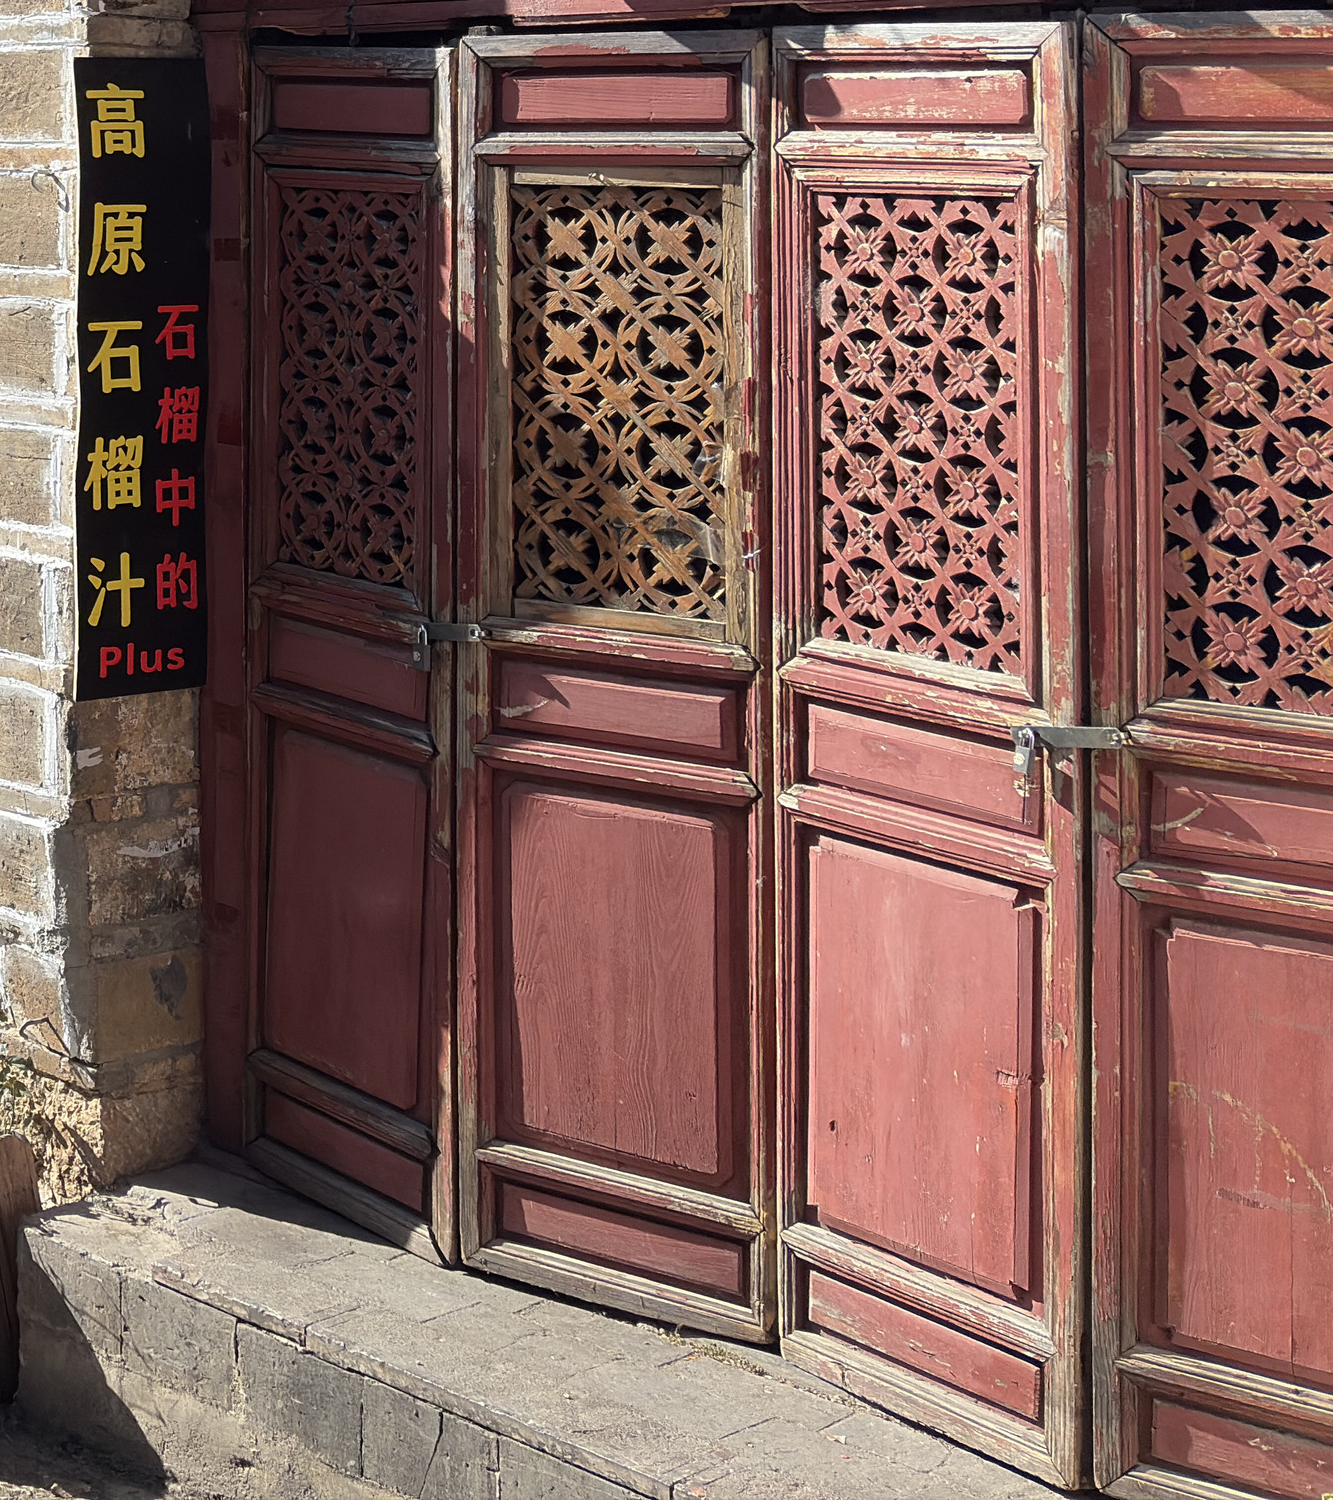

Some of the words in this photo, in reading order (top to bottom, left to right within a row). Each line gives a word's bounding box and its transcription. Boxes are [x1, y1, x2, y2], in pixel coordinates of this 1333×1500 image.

[84, 82, 148, 630] 高原石榴汁
[154, 303, 200, 611] 石榴中的
[98, 642, 186, 679] Plus
